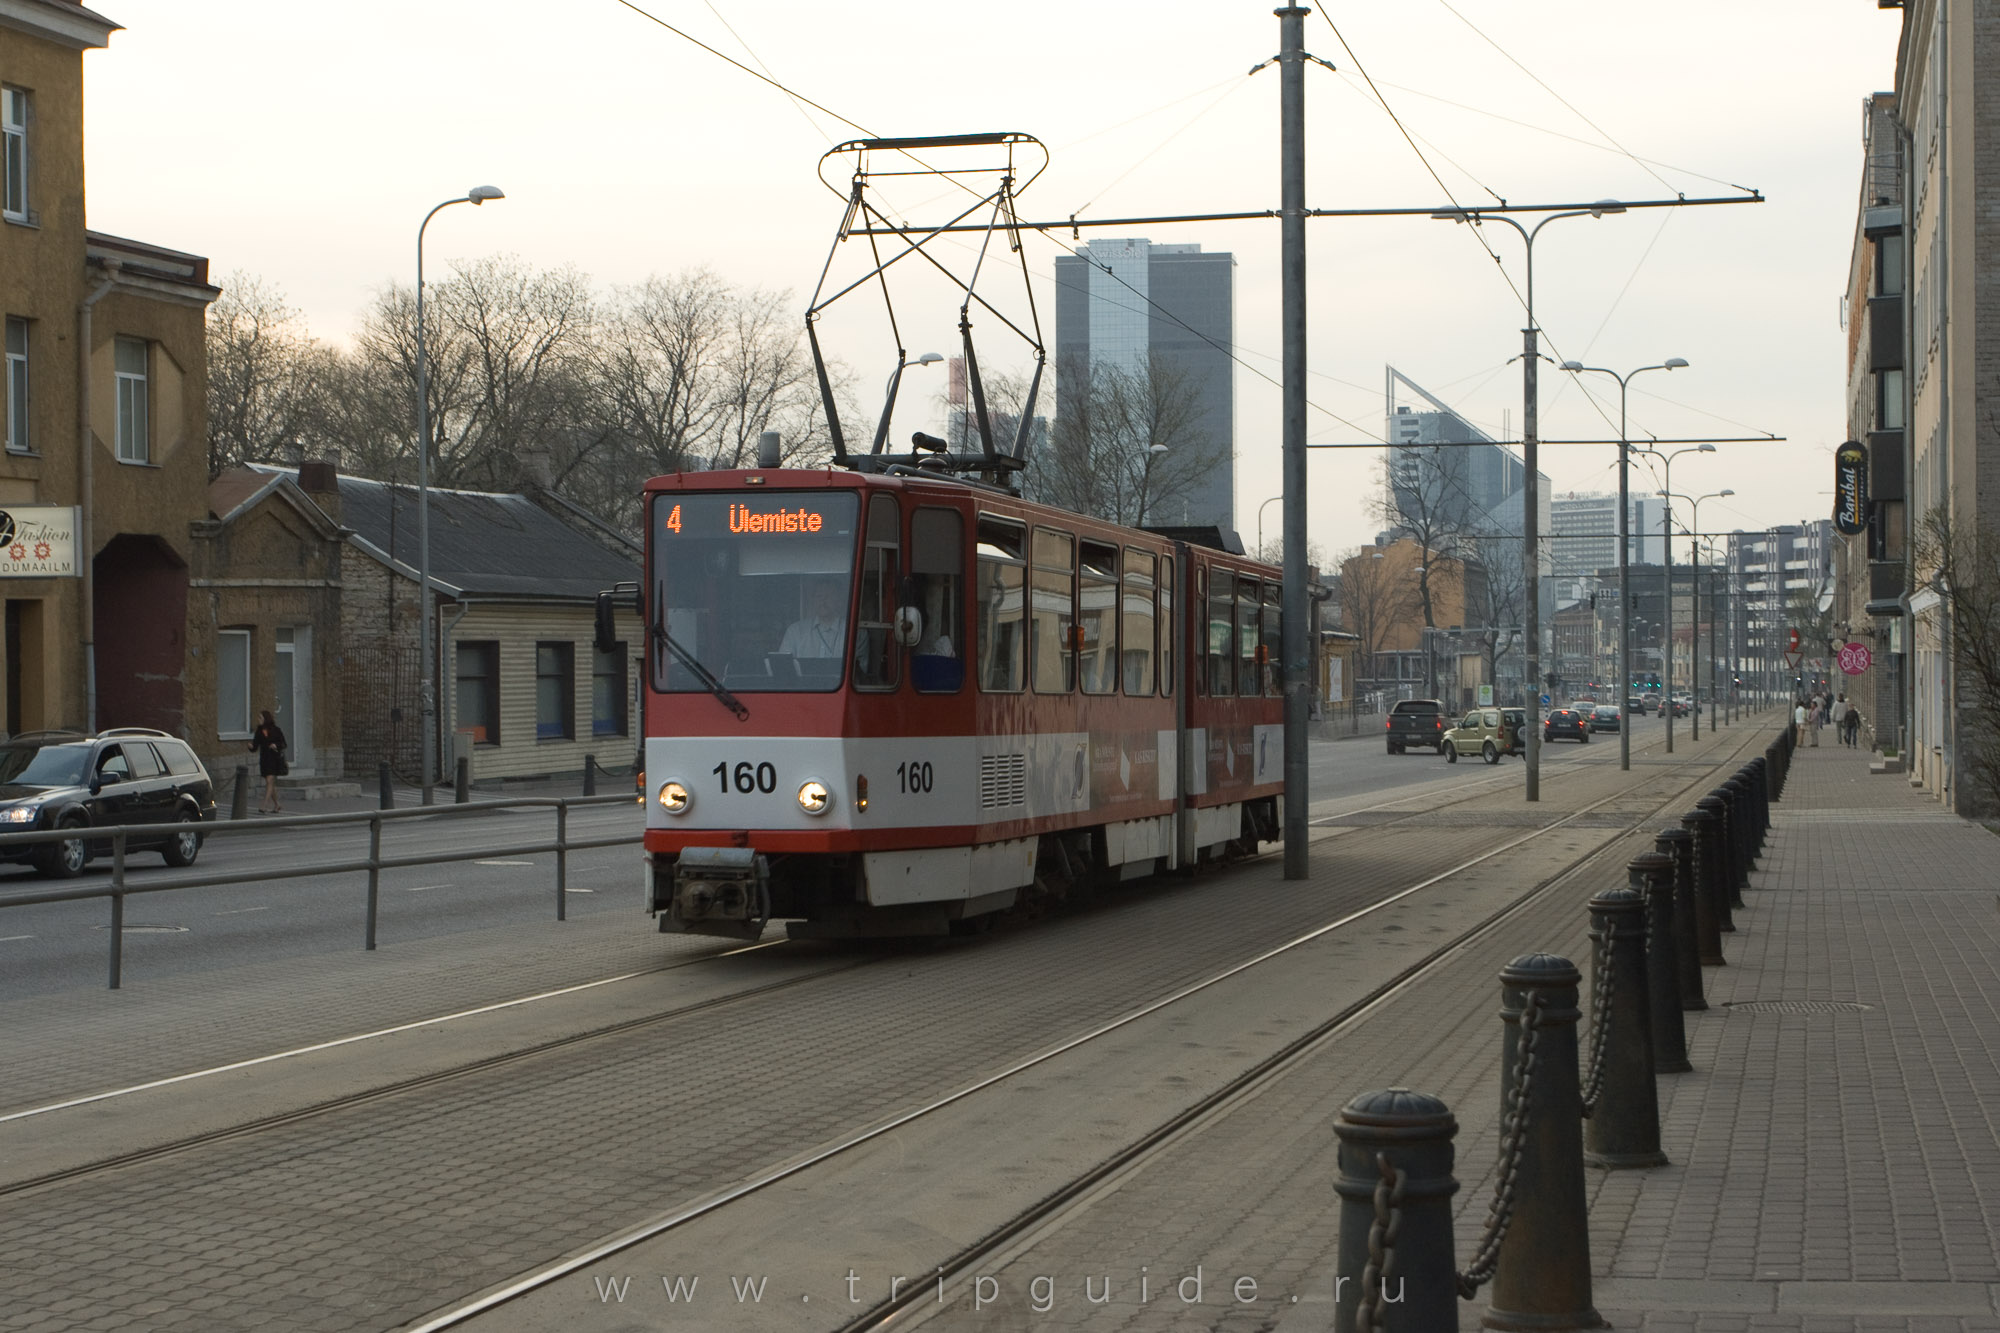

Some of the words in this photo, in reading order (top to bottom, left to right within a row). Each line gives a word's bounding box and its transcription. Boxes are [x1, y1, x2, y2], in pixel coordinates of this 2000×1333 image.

[1839, 466, 1857, 527] Baribal
[16, 520, 72, 541] Fashion
[666, 504, 682, 534] 4
[729, 504, 823, 533] Ülemiste
[712, 761, 777, 794] 160
[896, 761, 933, 794] 160
